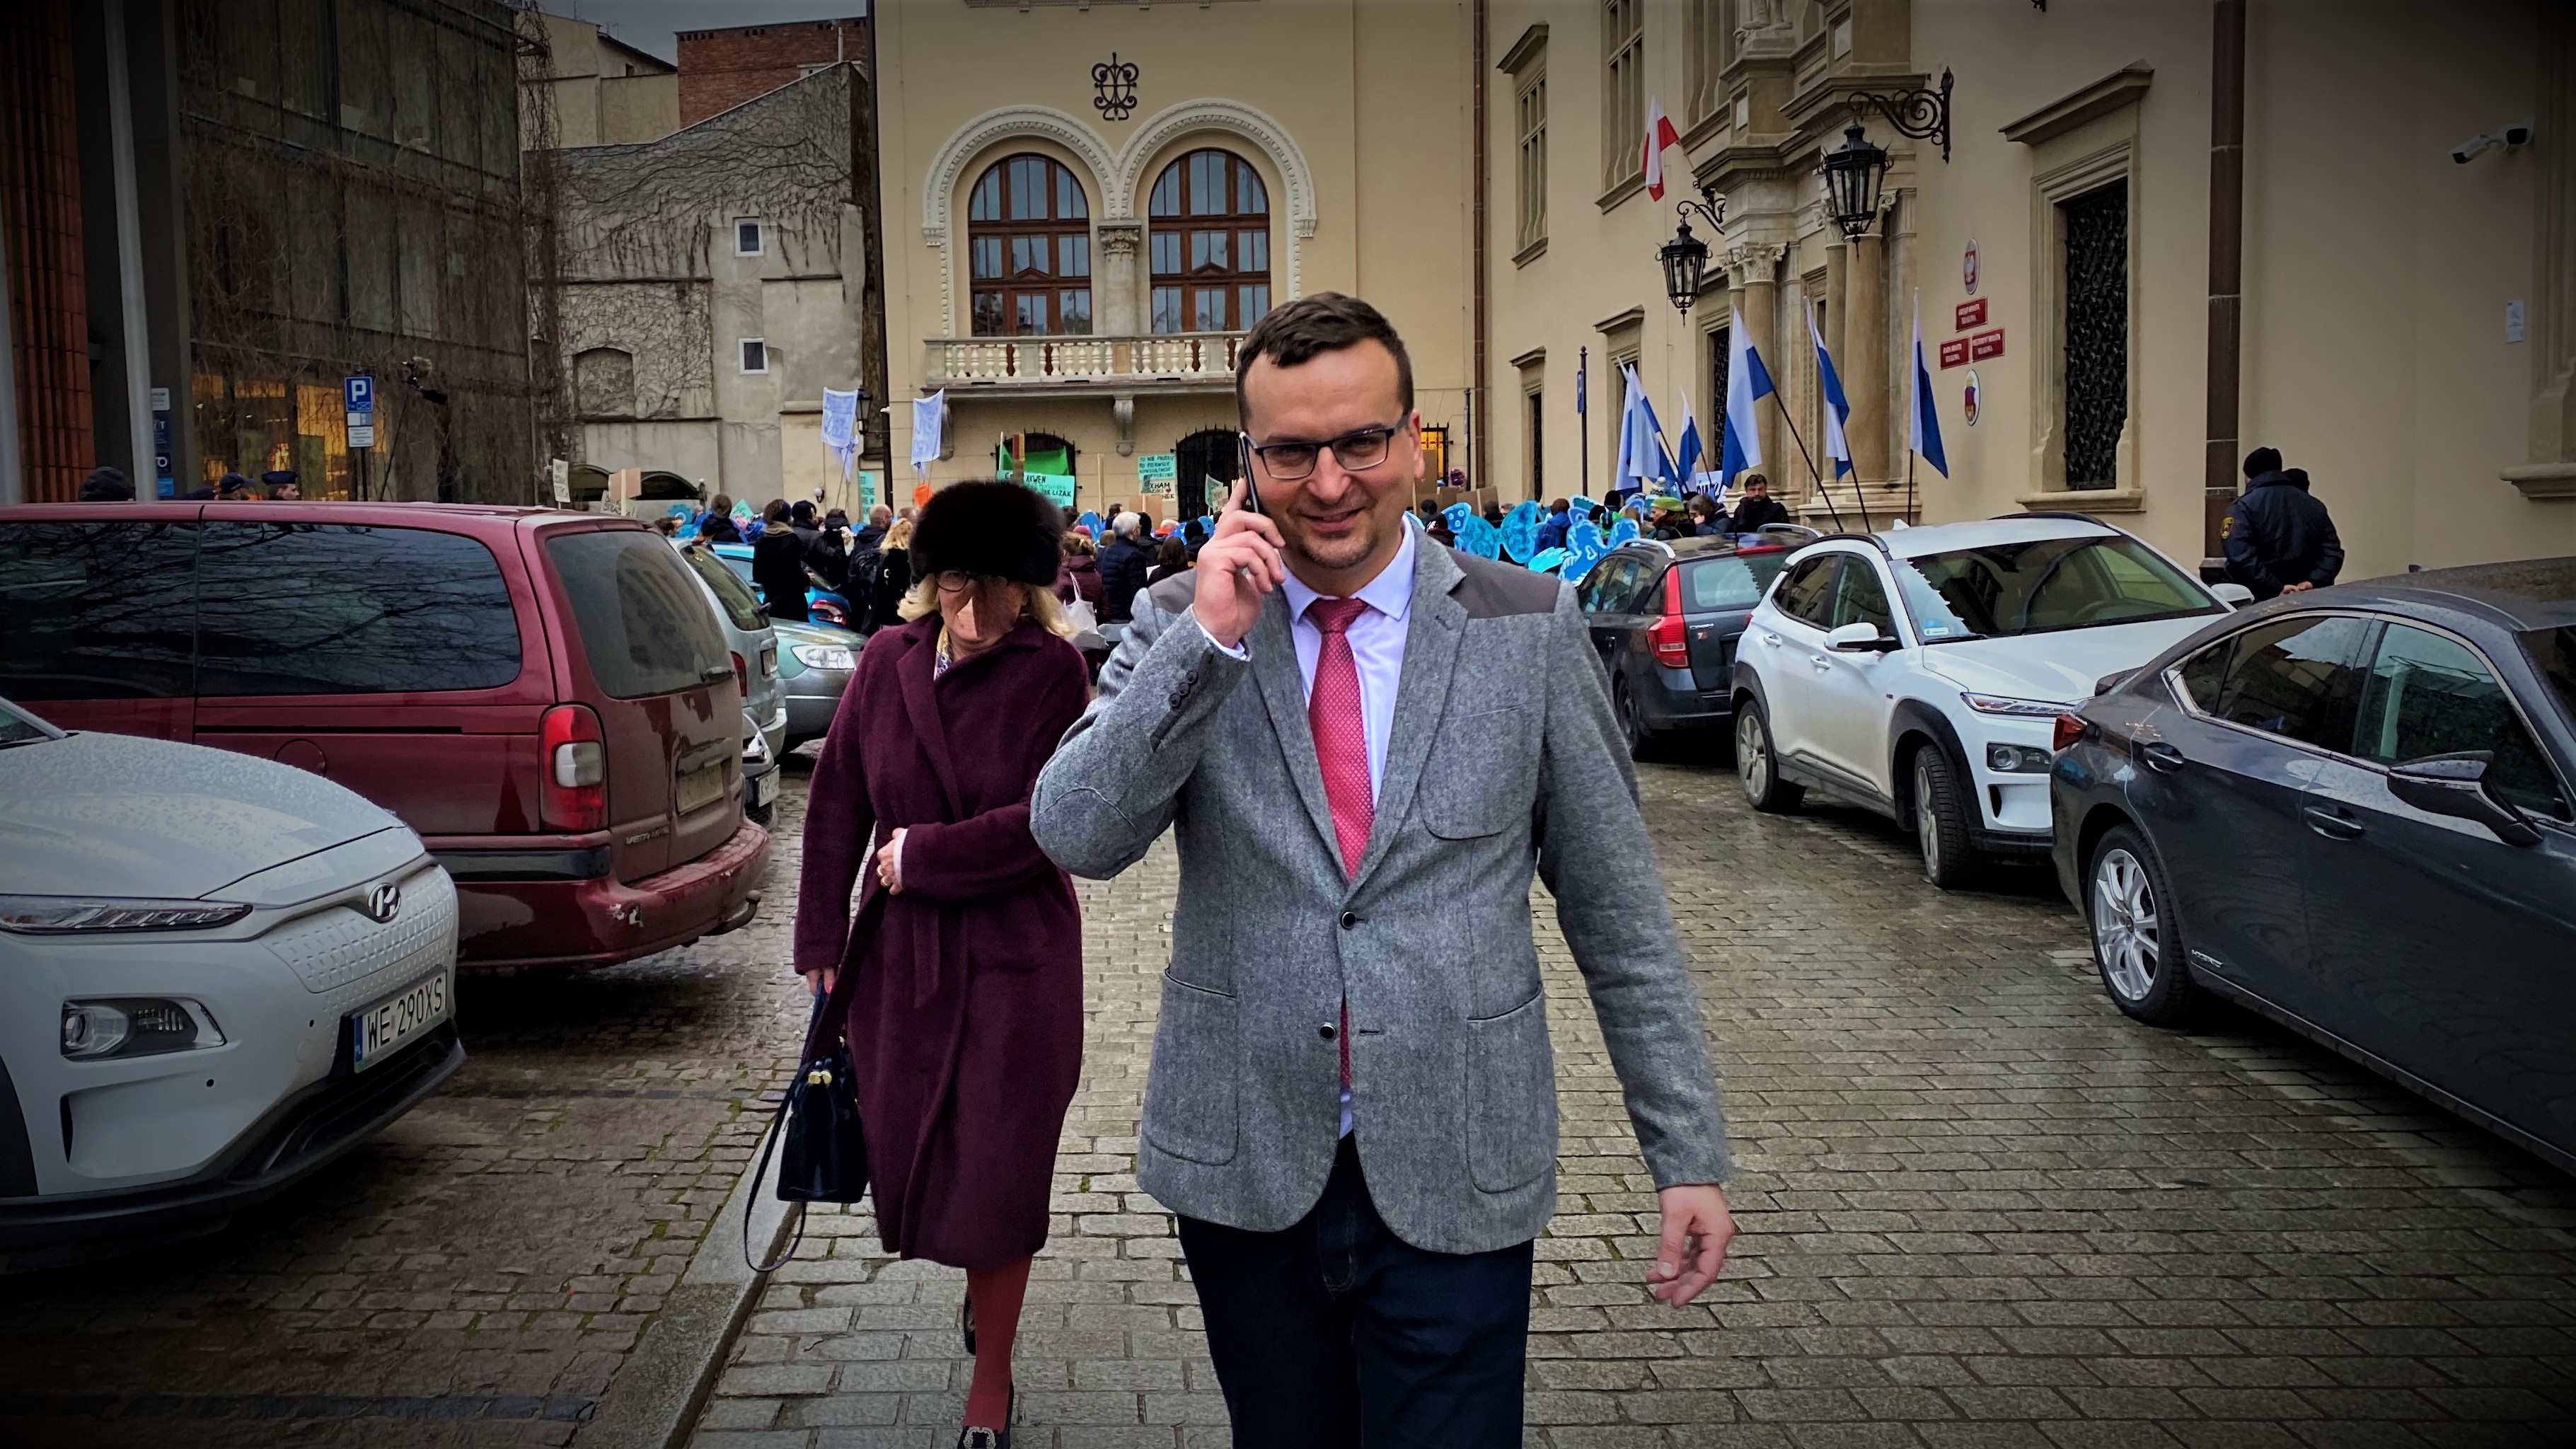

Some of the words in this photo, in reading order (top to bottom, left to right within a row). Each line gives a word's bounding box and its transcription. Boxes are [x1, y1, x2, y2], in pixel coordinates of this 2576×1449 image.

[351, 380, 366, 403] P
[367, 1005, 391, 1053] WE
[397, 977, 442, 1037] 290XS
